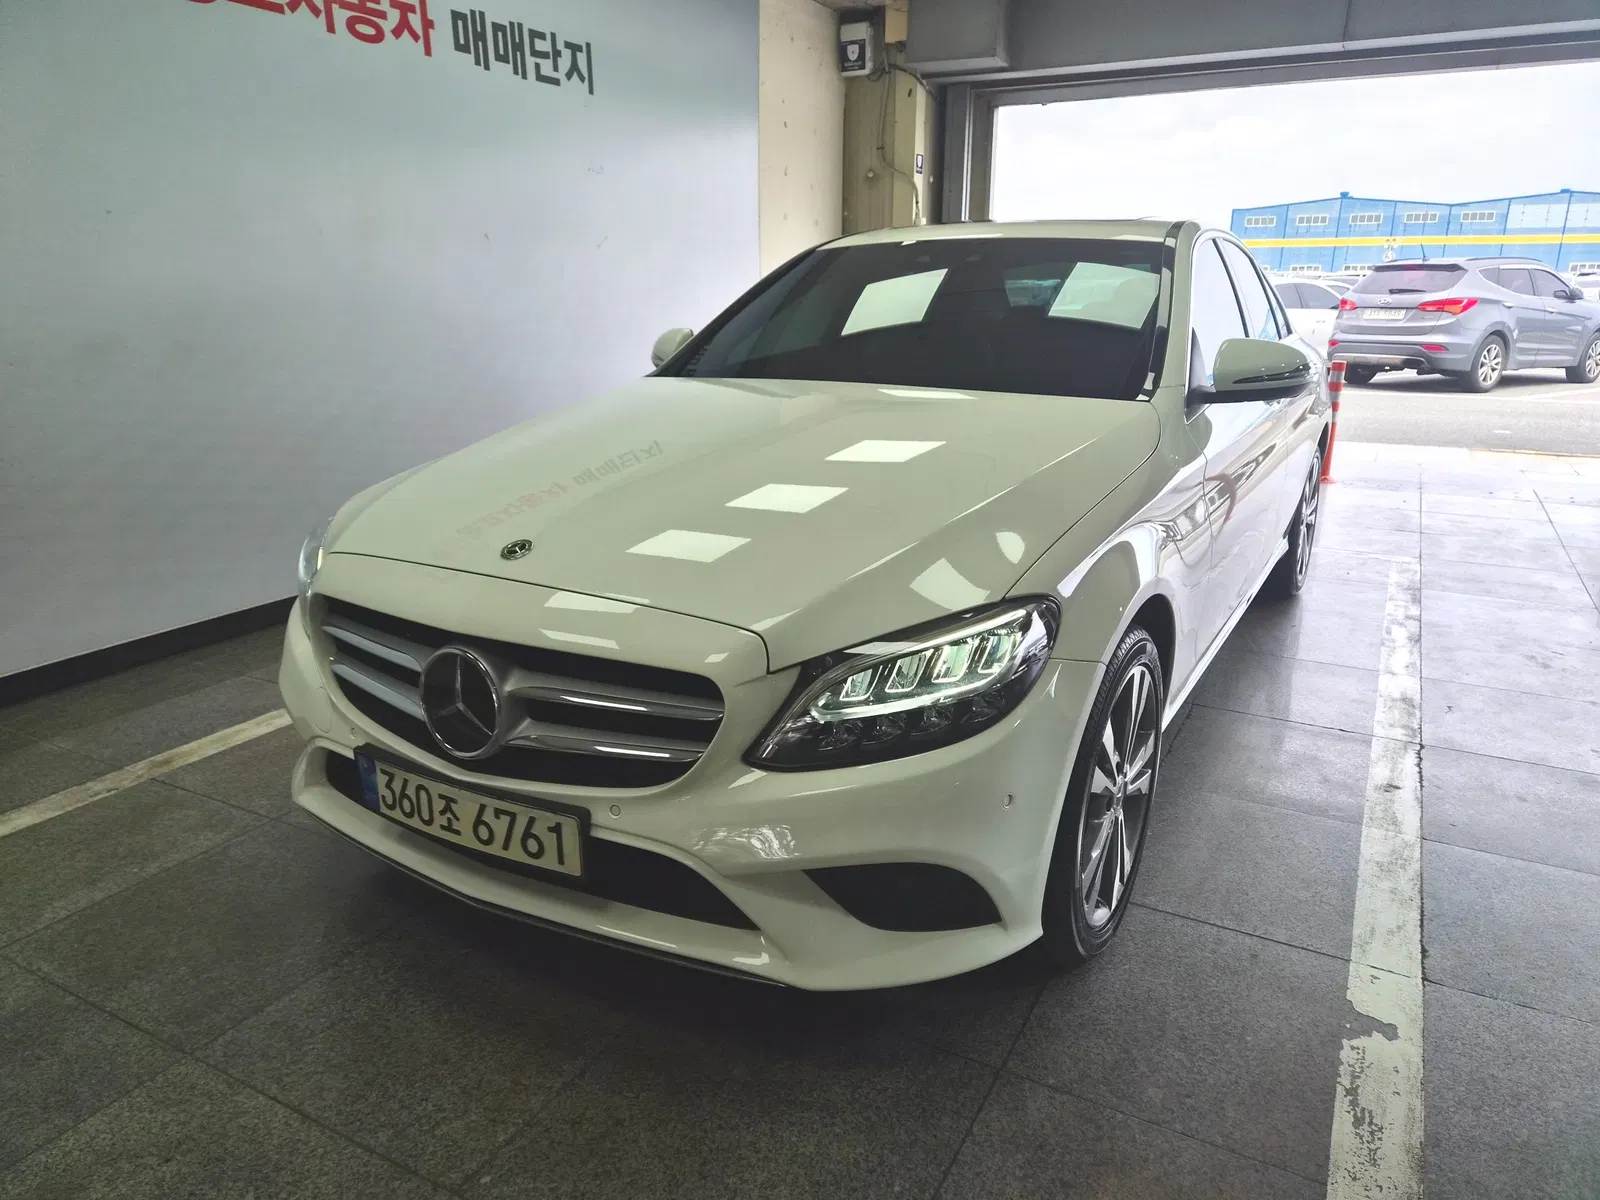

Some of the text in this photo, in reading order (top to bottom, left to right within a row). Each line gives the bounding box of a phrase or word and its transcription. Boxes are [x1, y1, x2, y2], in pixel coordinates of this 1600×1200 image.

[450, 8, 595, 96] 매매단지
[380, 768, 565, 866] 360조 6761
